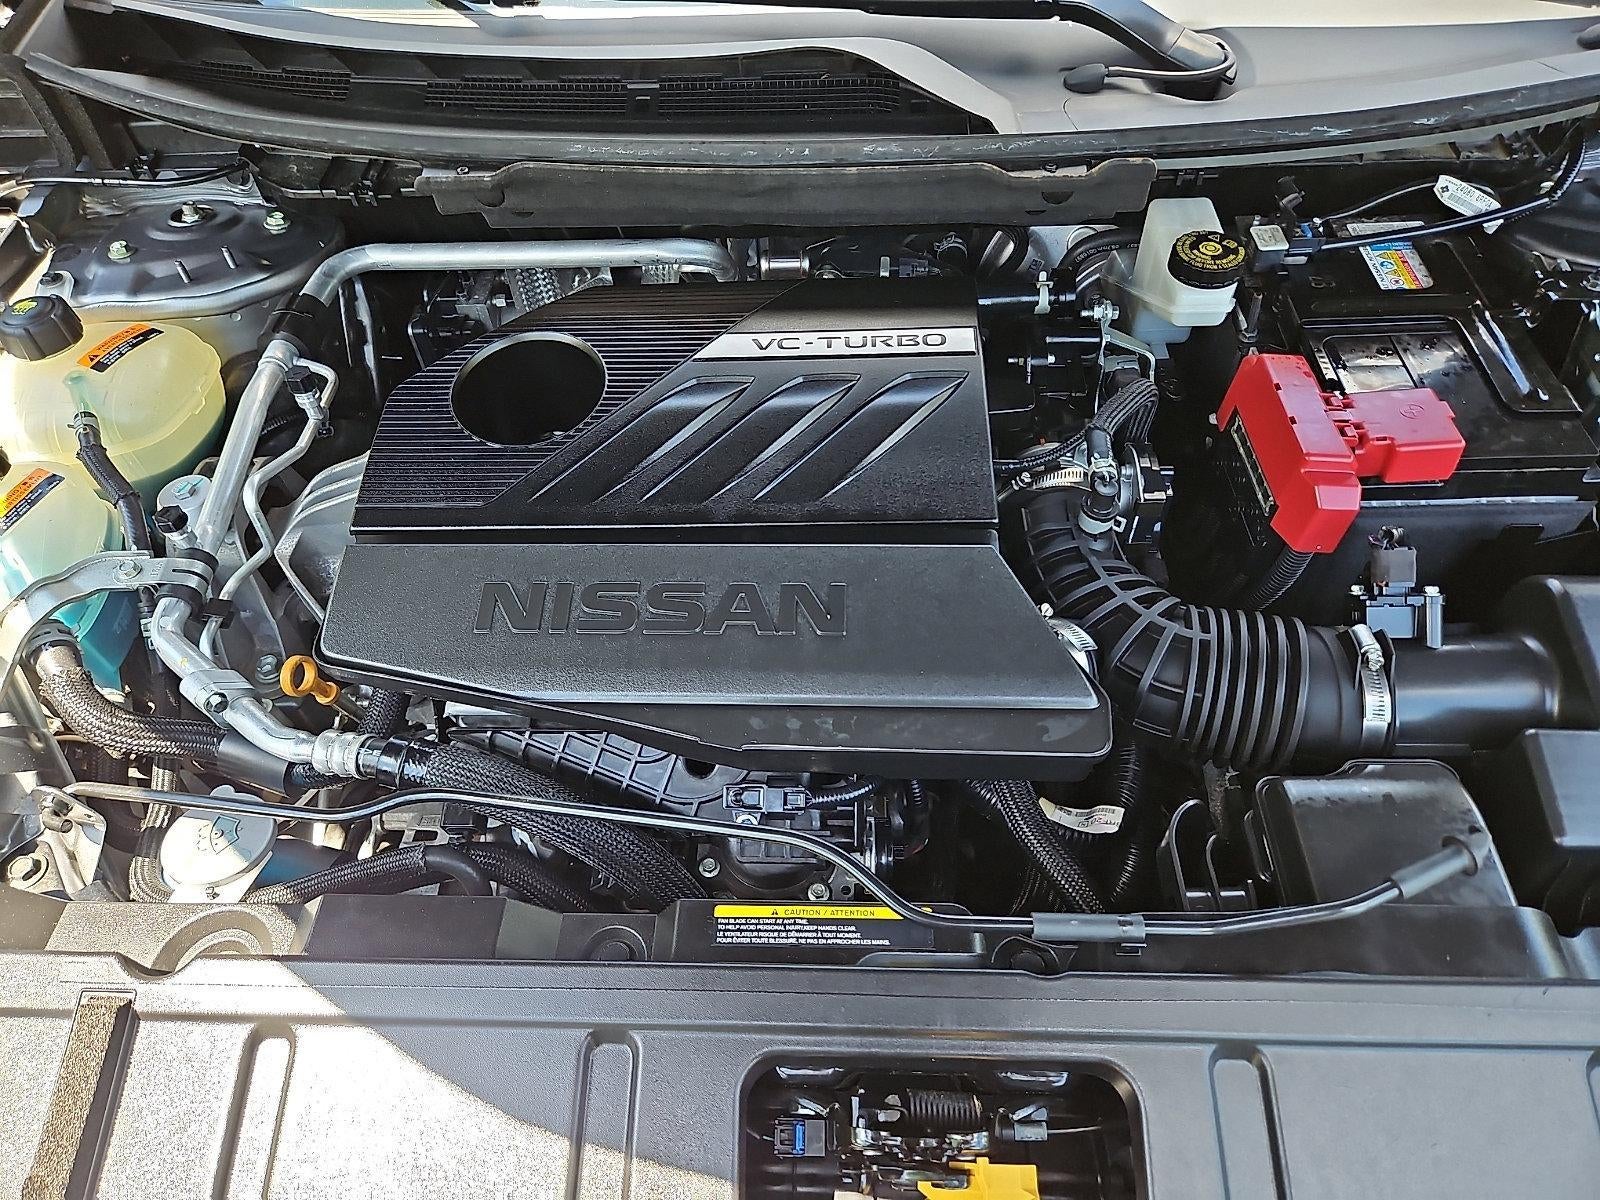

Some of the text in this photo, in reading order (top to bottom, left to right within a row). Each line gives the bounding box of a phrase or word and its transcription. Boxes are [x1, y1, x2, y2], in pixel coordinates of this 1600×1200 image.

[752, 333, 947, 351] VC-TURBO
[473, 581, 847, 635] NISSAN
[830, 909, 875, 917] ATTENTION
